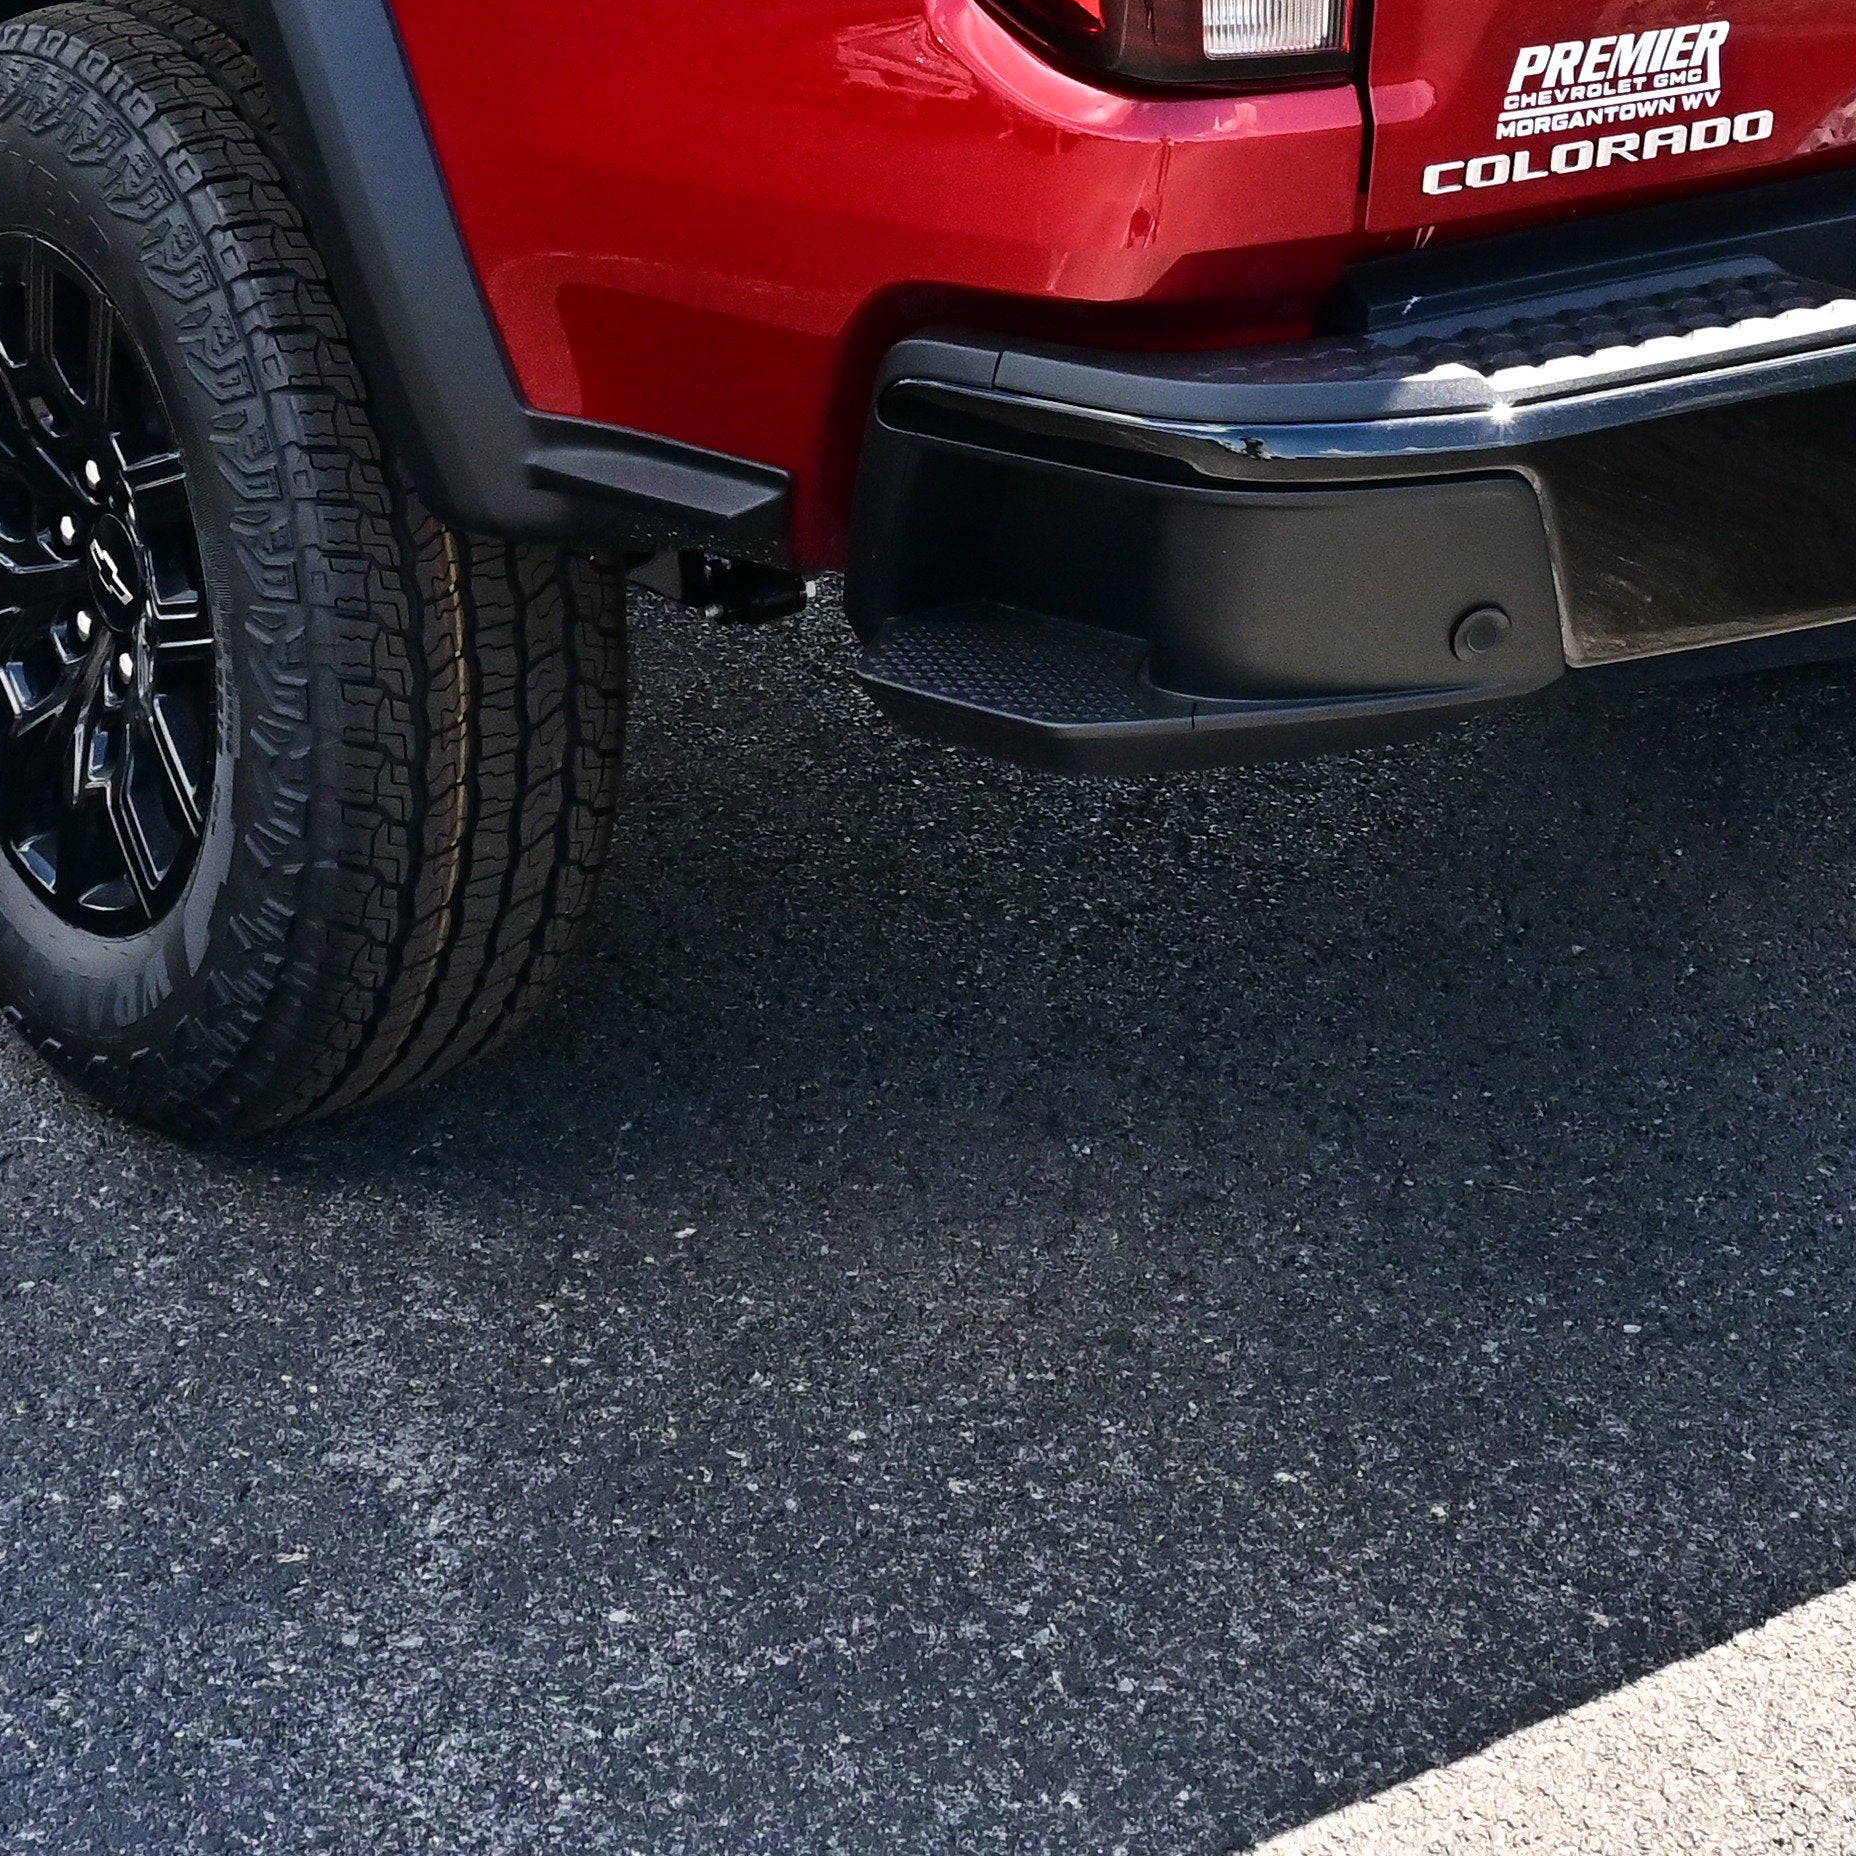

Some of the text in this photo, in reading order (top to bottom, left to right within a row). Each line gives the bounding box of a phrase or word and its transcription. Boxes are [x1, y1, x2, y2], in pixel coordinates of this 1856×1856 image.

[1506, 20, 1730, 93] PREMIER
[1496, 89, 1722, 140] MORGANTOWN WV
[1503, 68, 1703, 111] CHEVROLET GMC
[1422, 109, 1774, 195] COLORADO
